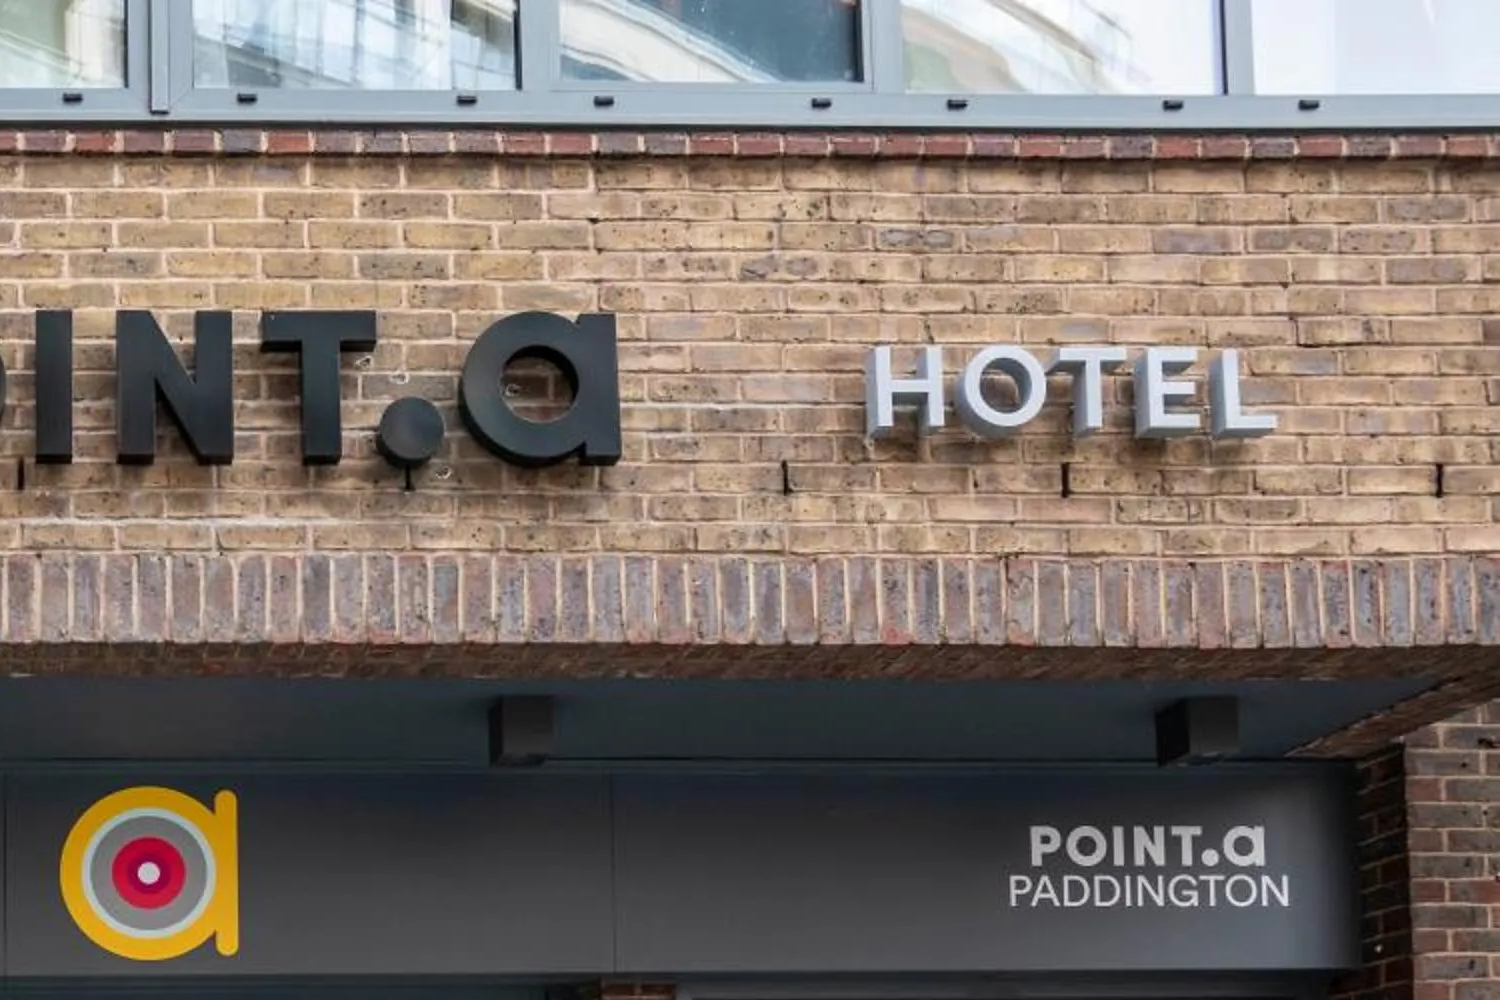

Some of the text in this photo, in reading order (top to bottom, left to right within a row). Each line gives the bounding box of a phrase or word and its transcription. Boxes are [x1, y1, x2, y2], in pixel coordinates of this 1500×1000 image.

[866, 344, 1278, 440] HOTEL
[1029, 825, 1266, 867] POINT.a
[1009, 874, 1290, 907] PADDINGTON
